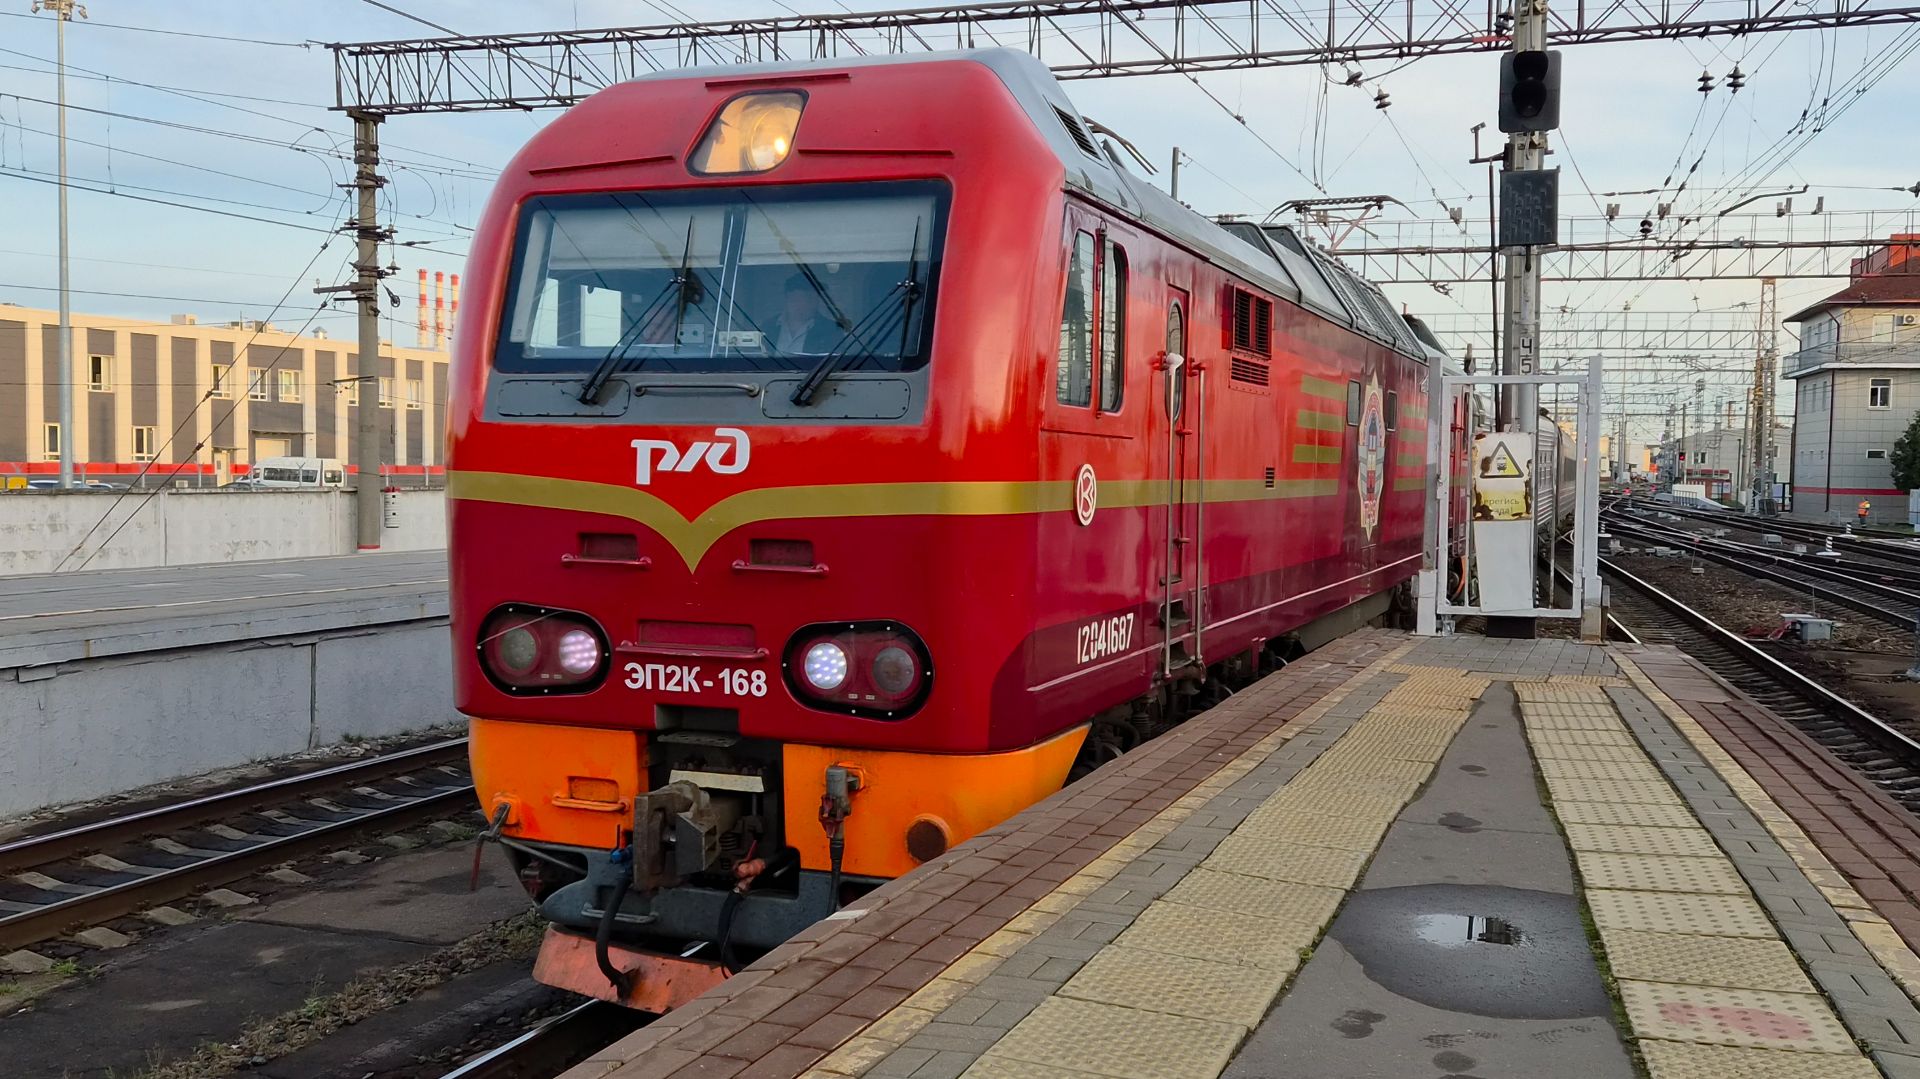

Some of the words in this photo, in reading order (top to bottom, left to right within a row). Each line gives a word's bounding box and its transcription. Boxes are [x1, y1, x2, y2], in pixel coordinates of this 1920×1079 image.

[1481, 497, 1520, 506] ерегись
[1077, 612, 1134, 665] 12041687
[624, 662, 767, 697] ЭП2К-168
